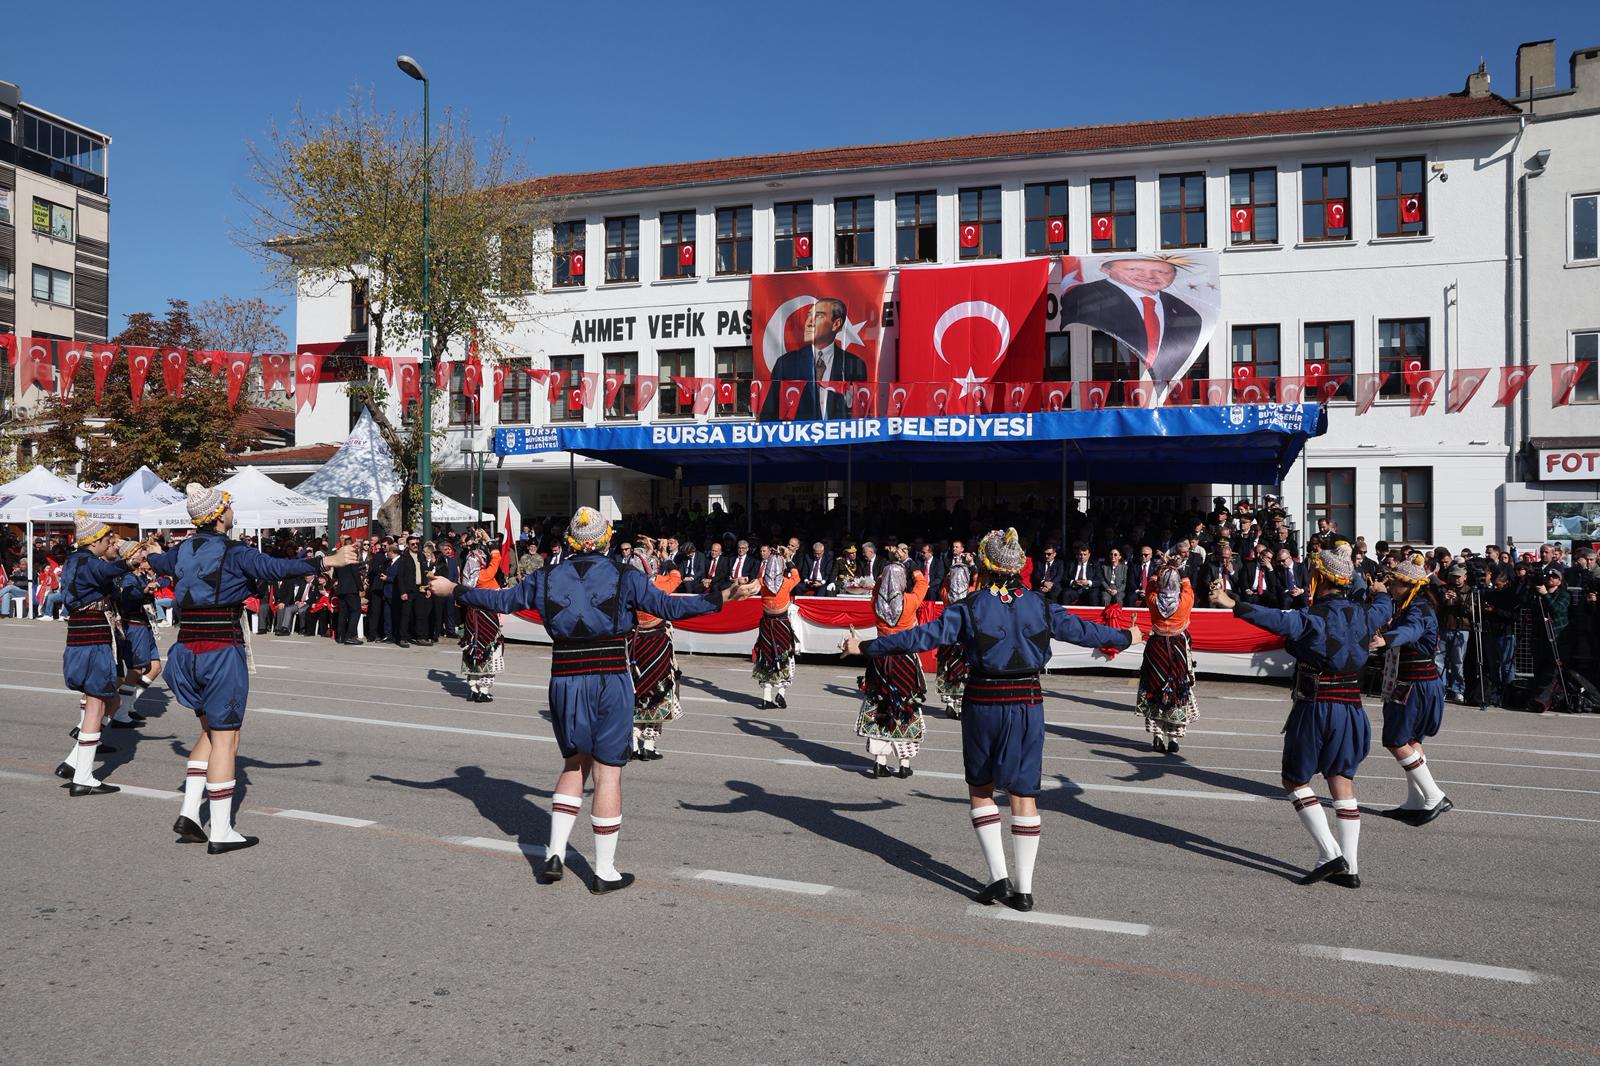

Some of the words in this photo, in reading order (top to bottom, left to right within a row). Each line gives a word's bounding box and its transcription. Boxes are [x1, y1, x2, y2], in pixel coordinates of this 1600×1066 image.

[571, 316, 637, 344] AHMET
[648, 307, 706, 340] VEFİK
[1258, 410, 1303, 423] BÜYÜŞEHİR
[526, 428, 557, 436] BURSA
[652, 426, 726, 444] BURSA
[732, 418, 881, 444] BÜYÜKŞEHİR
[888, 413, 1033, 437] BELEDİYESİ
[526, 441, 558, 450] BELEDİYESİ
[1546, 452, 1600, 473] FOT
